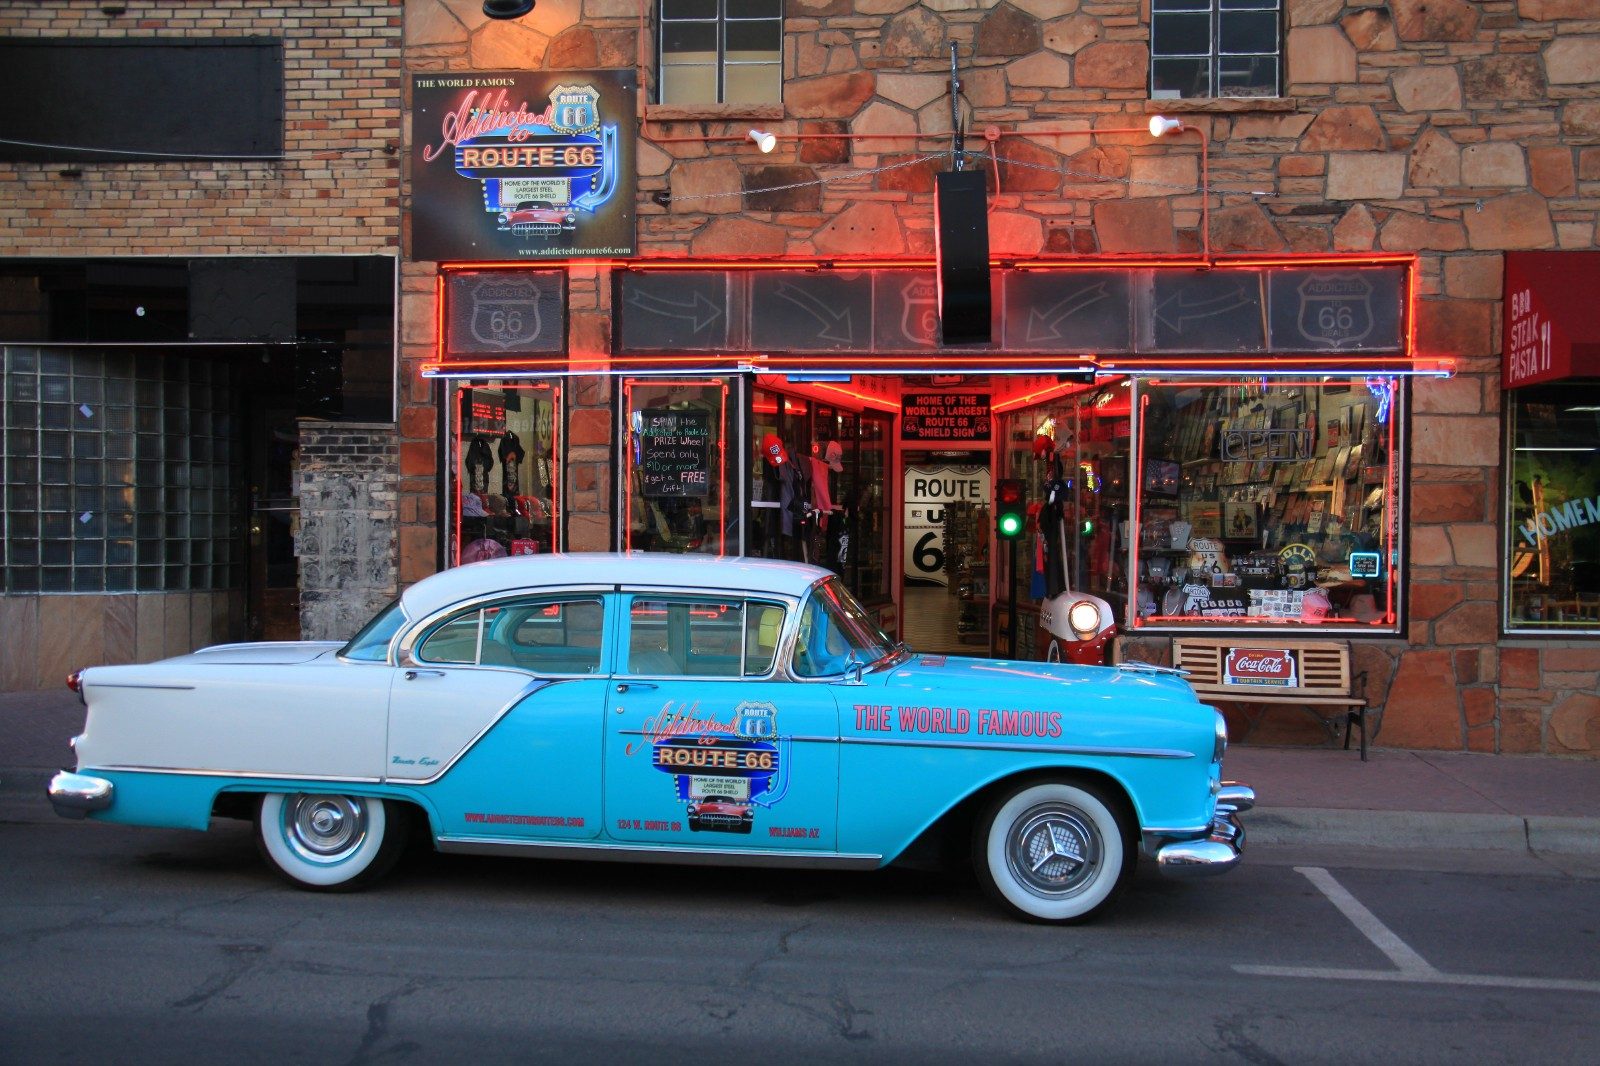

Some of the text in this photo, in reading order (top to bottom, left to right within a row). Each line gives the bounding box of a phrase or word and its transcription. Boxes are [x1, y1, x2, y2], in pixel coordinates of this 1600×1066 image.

[416, 78, 515, 88] THE WORLD FAMOUS
[559, 94, 589, 104] ROUTE
[562, 107, 588, 127] 66
[423, 89, 553, 162] Addicted
[506, 125, 535, 142] to
[463, 146, 596, 168] ROUTE 66
[518, 246, 632, 256] www.addictedtoroute66.com
[490, 310, 523, 333] 66
[1318, 306, 1353, 330] 66
[1510, 312, 1539, 352] STEAK
[1509, 345, 1538, 383] PASTA
[916, 396, 977, 405] HOME OF THE
[905, 406, 988, 416] WORLD'S LARGEST
[680, 417, 698, 426] the
[925, 417, 969, 427] ROUTE 66
[918, 427, 975, 438] SHIELD SIGN
[654, 436, 704, 446] PRIZE Wheel
[1225, 431, 1310, 459] OPEN
[646, 448, 700, 465] Spend only
[661, 464, 673, 472] or
[676, 463, 699, 471] more
[680, 471, 706, 483] FREE
[913, 478, 981, 498] ROUTE
[744, 708, 769, 717] ROUTE
[625, 700, 740, 756] Addicted
[745, 719, 767, 736] 66
[853, 704, 1063, 739] THE WORLD FAMOUS
[697, 734, 720, 745] to
[659, 747, 773, 769] ROUTE 66
[618, 819, 682, 832] 124 W. ROUTE 66
[769, 826, 820, 839] WILLIAMS AZ
